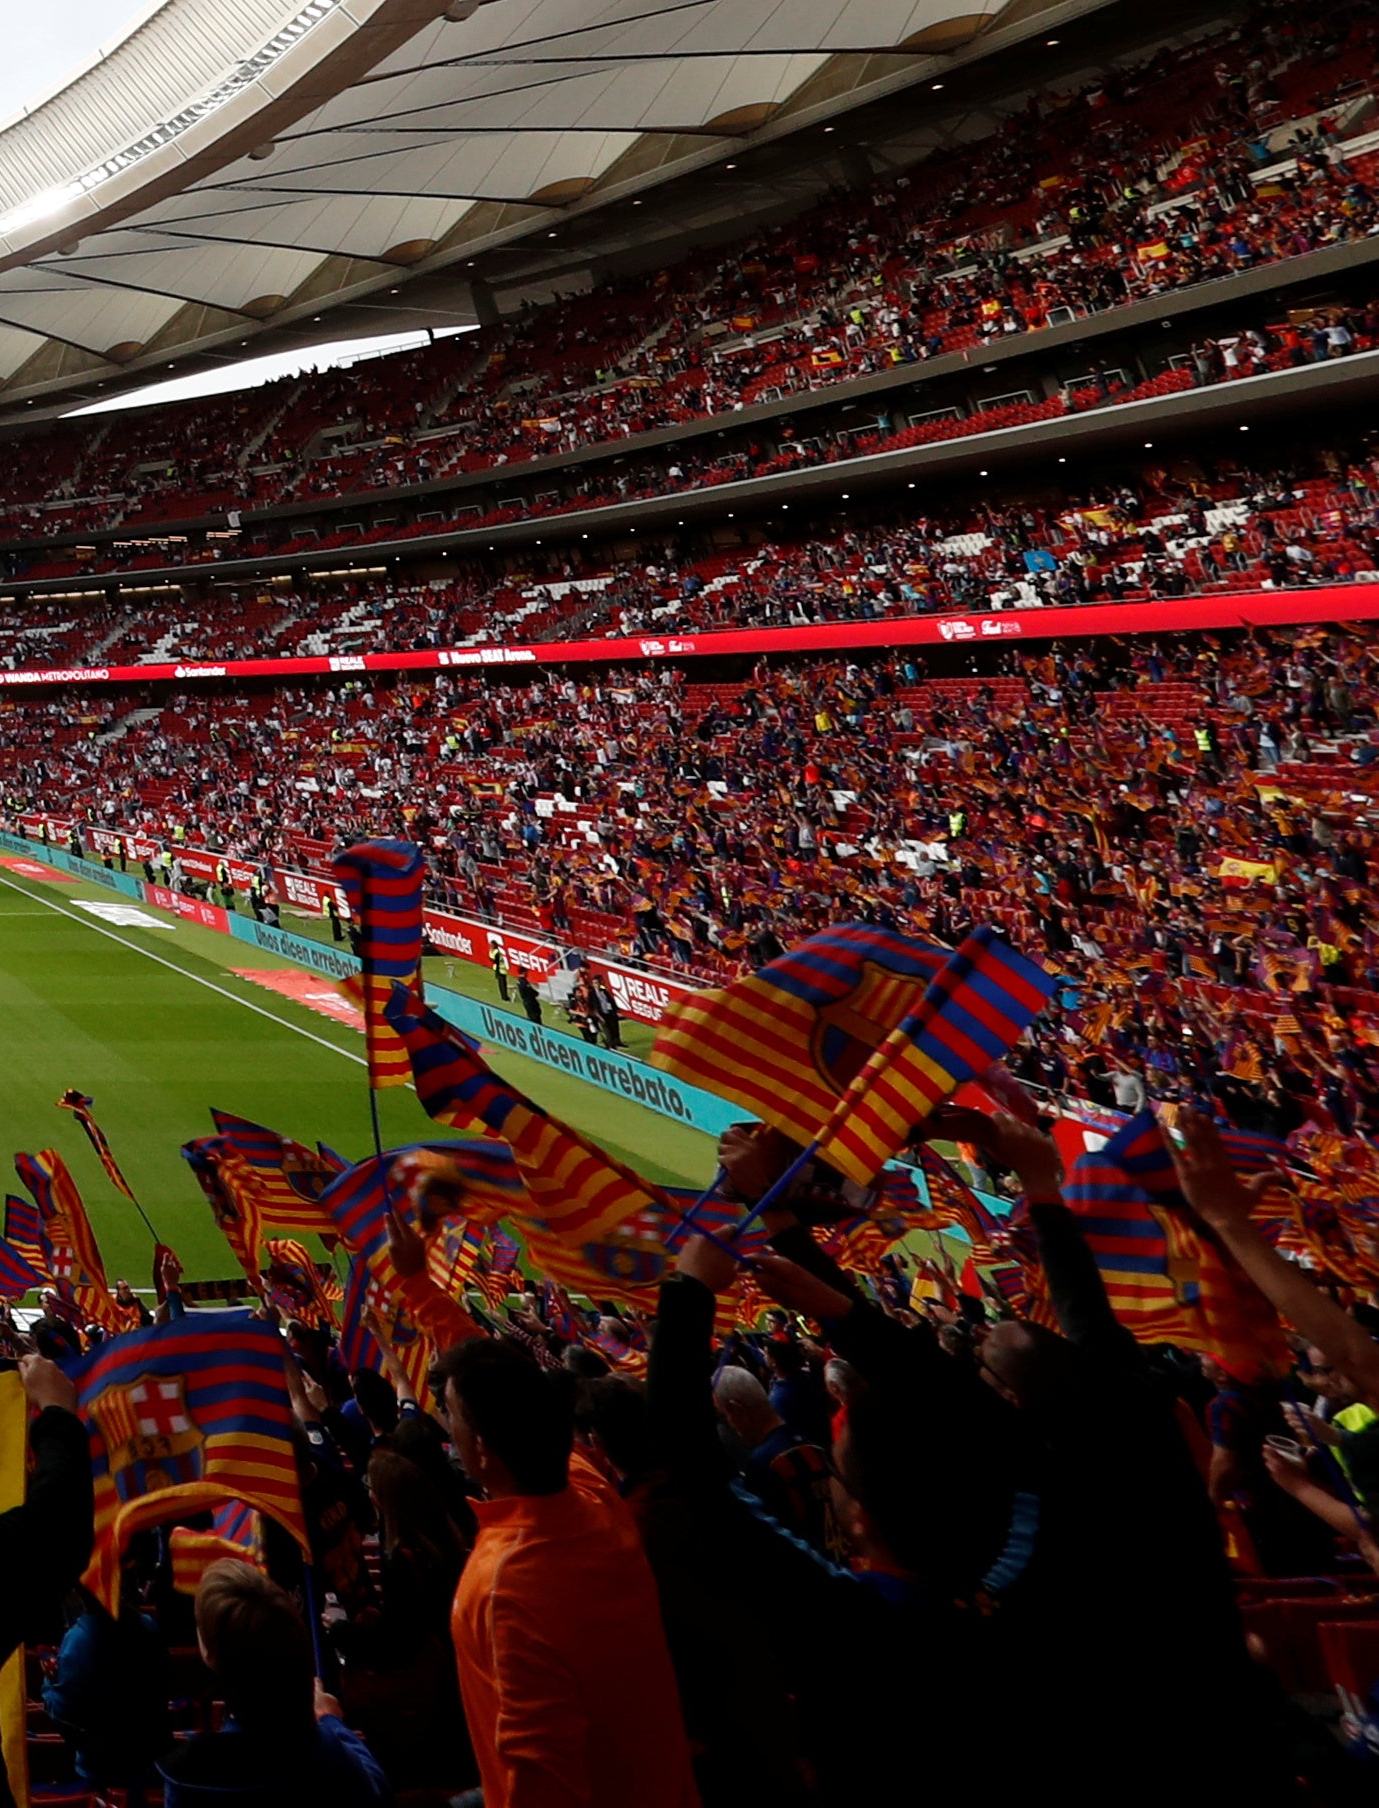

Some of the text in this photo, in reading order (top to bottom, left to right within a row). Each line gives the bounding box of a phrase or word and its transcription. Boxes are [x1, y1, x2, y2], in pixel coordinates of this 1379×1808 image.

[481, 649, 504, 662] SEAT
[4, 669, 110, 683] WANDA METROPOLITANO
[185, 667, 226, 677] Santander
[254, 924, 280, 954] Unos
[281, 934, 310, 965] dicen
[426, 922, 473, 955] Santander
[508, 947, 549, 972] SEAT
[625, 976, 670, 1008] REALE
[480, 1006, 693, 1121] Unos dicen arrebato.
